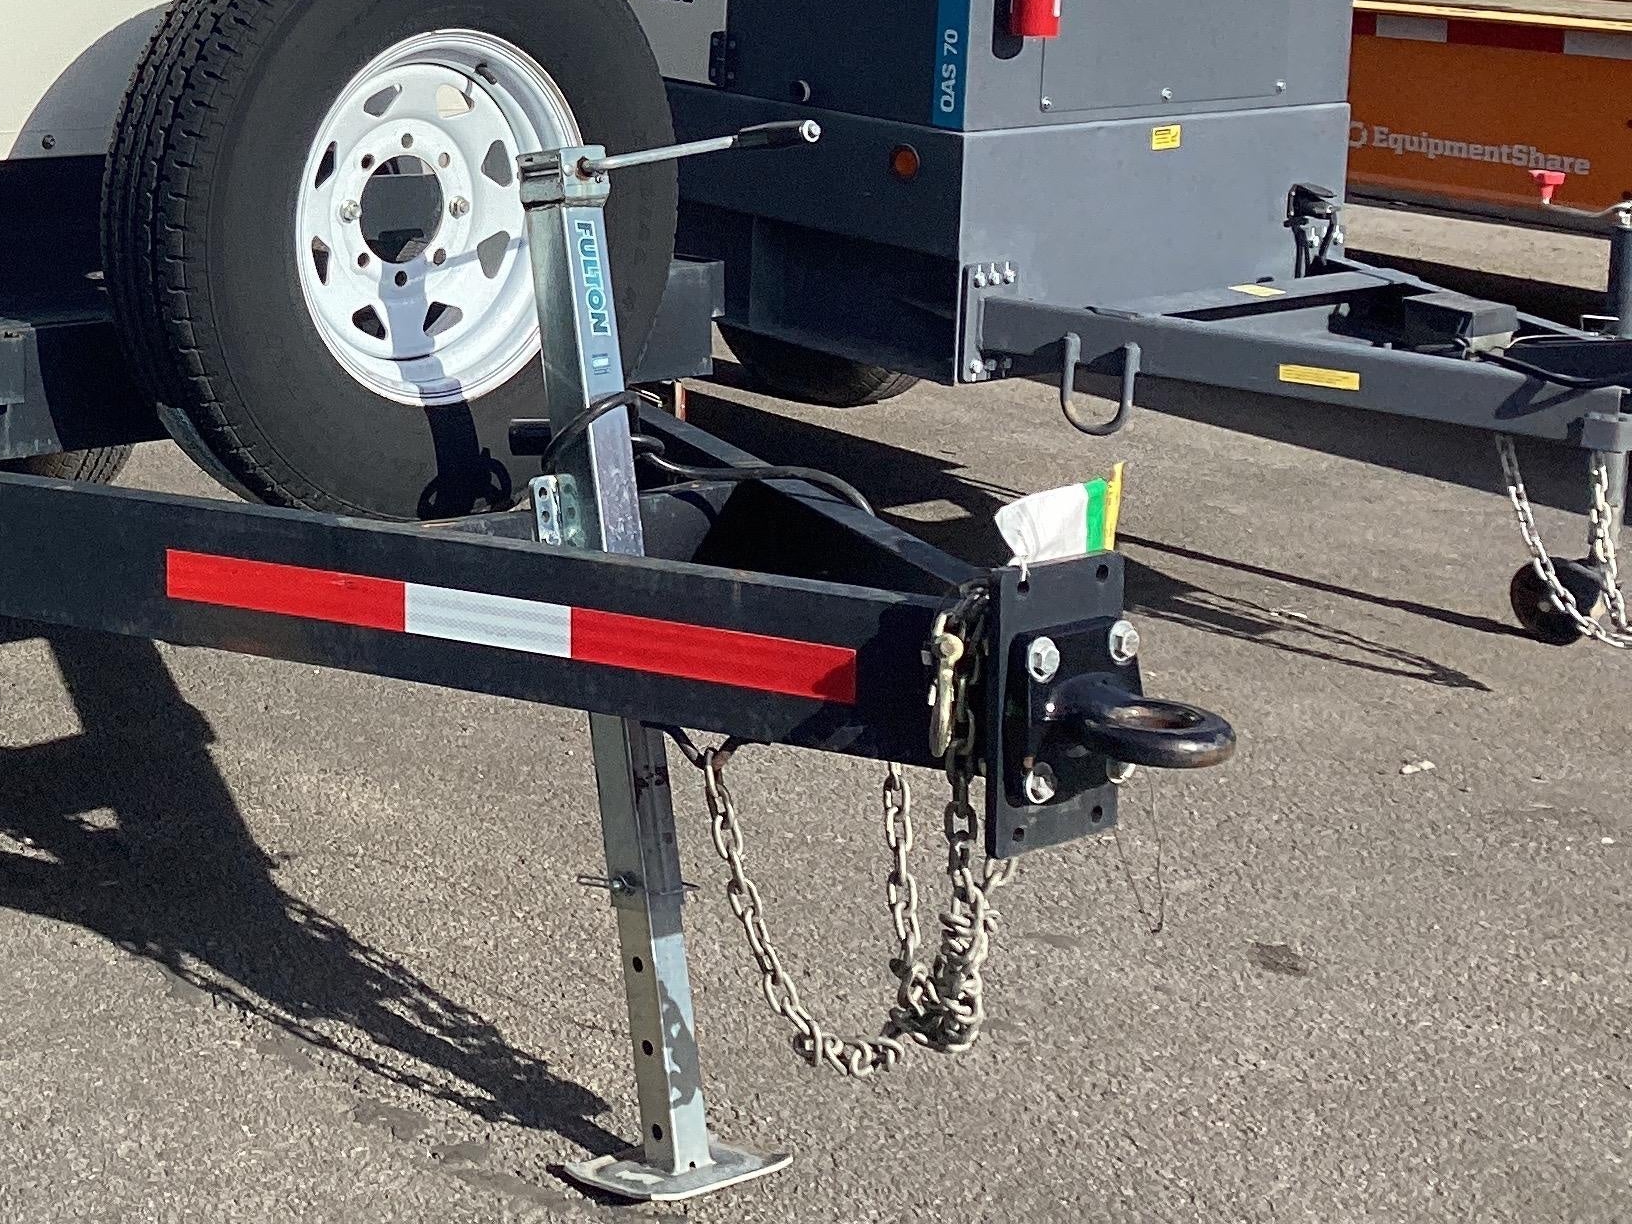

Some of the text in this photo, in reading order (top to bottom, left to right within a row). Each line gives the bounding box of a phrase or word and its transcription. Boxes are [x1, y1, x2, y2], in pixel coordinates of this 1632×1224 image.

[940, 28, 959, 113] QAS 70
[1373, 126, 1591, 176] EquipmentShare
[574, 219, 612, 337] FULTON
